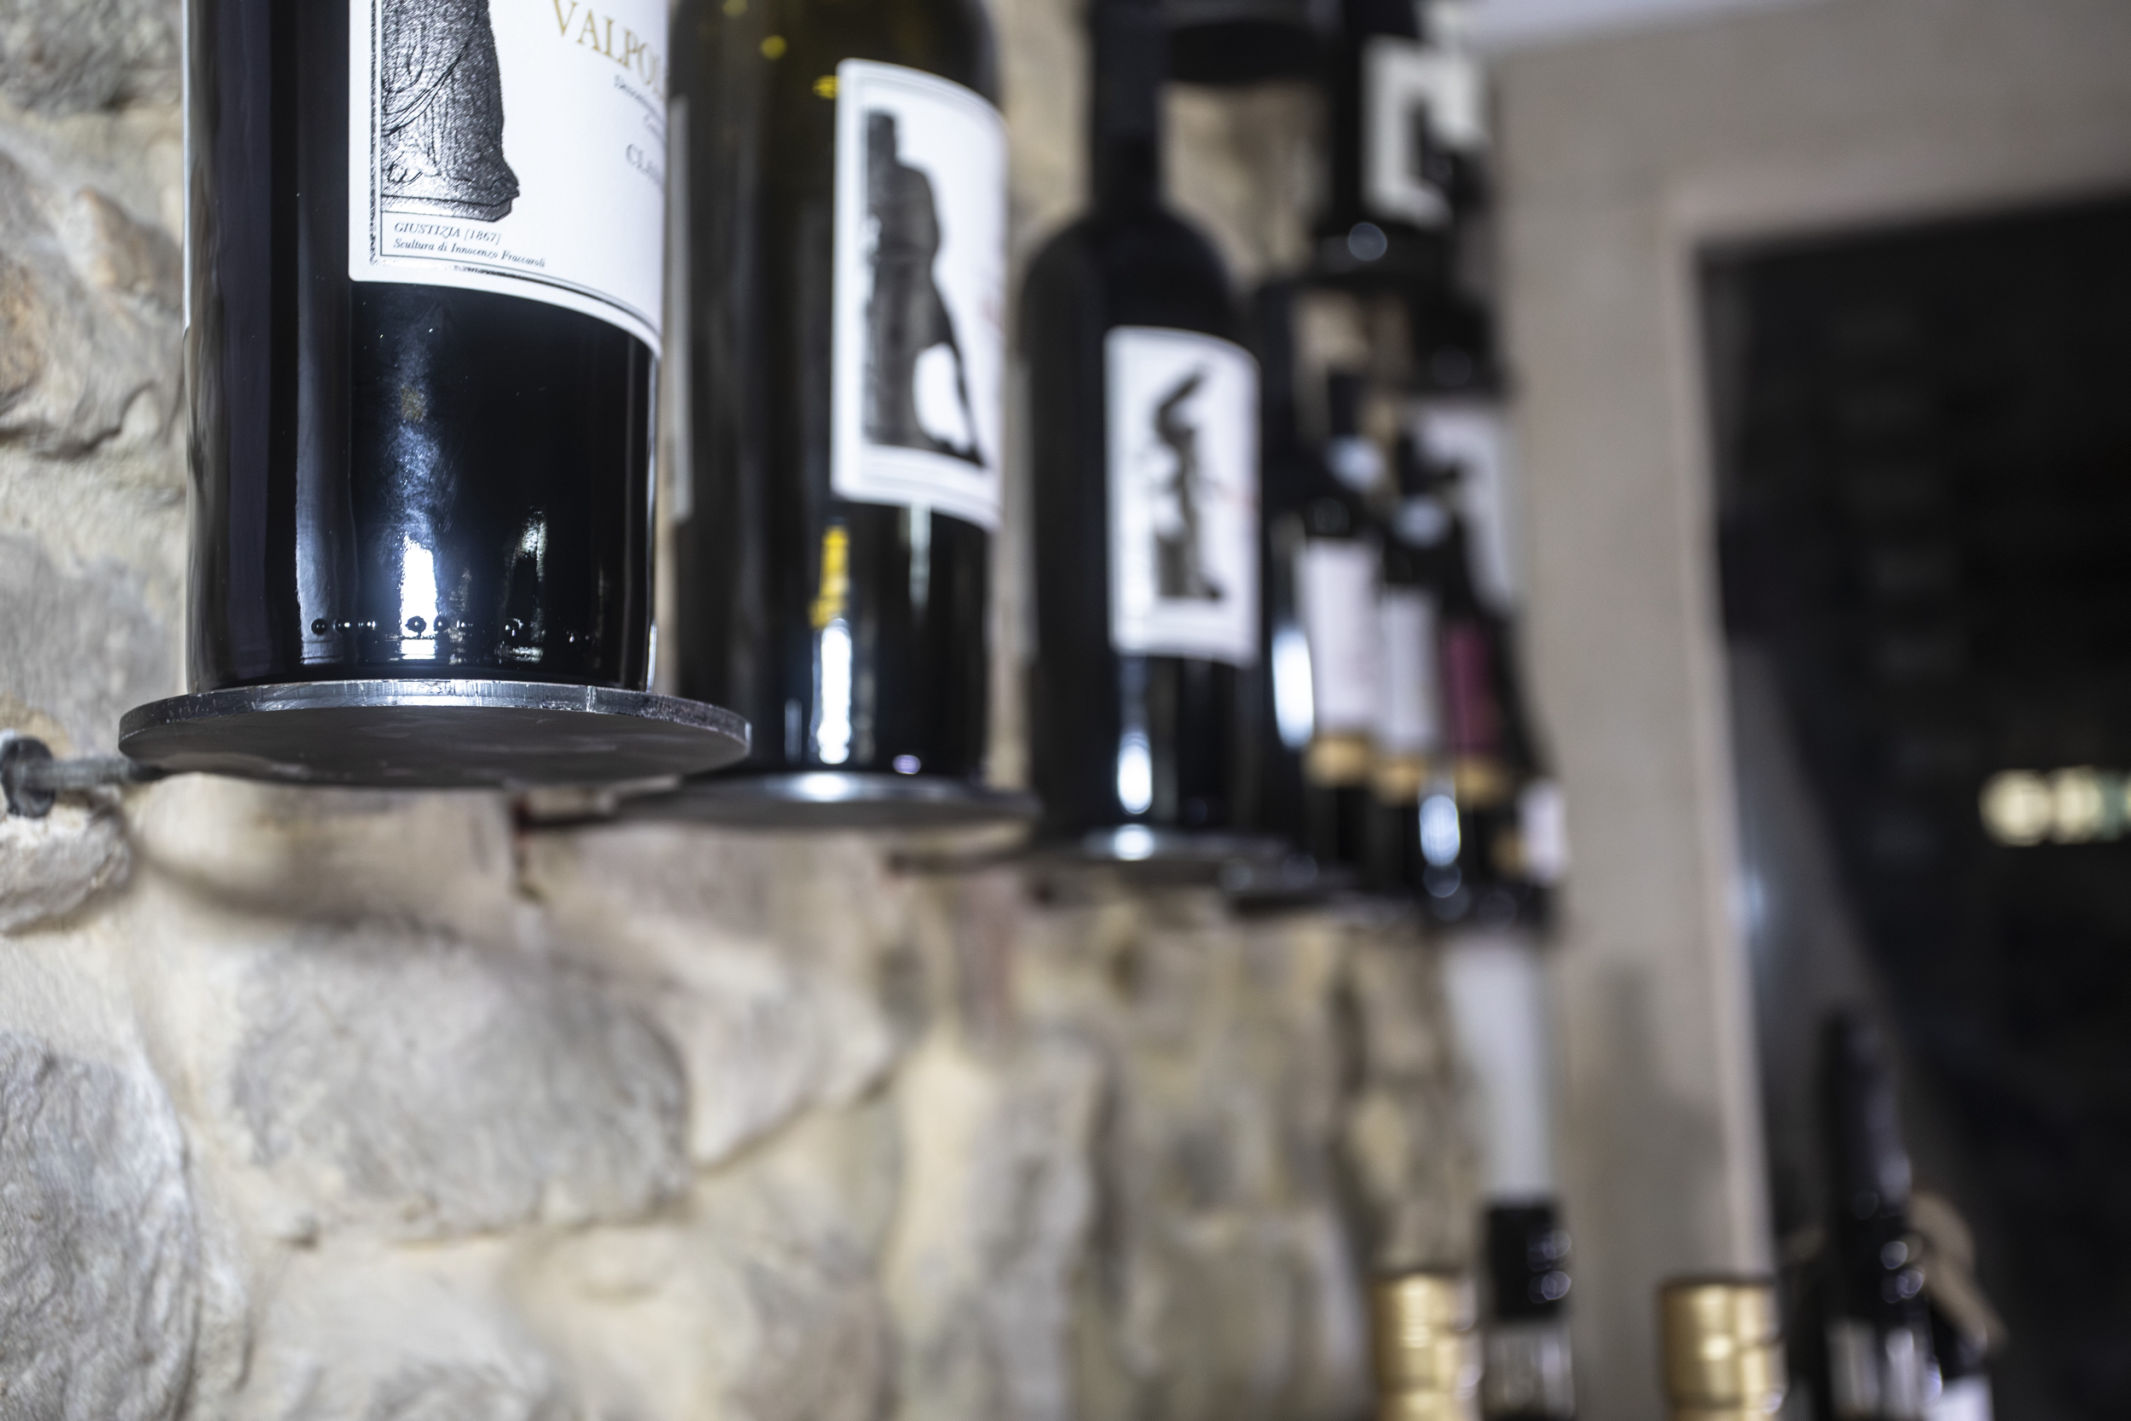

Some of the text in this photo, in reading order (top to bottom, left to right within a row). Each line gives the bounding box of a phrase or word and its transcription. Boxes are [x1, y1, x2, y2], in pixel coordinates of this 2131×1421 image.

[393, 238, 546, 268] Scultura di Innocenzo Fraccaroli
